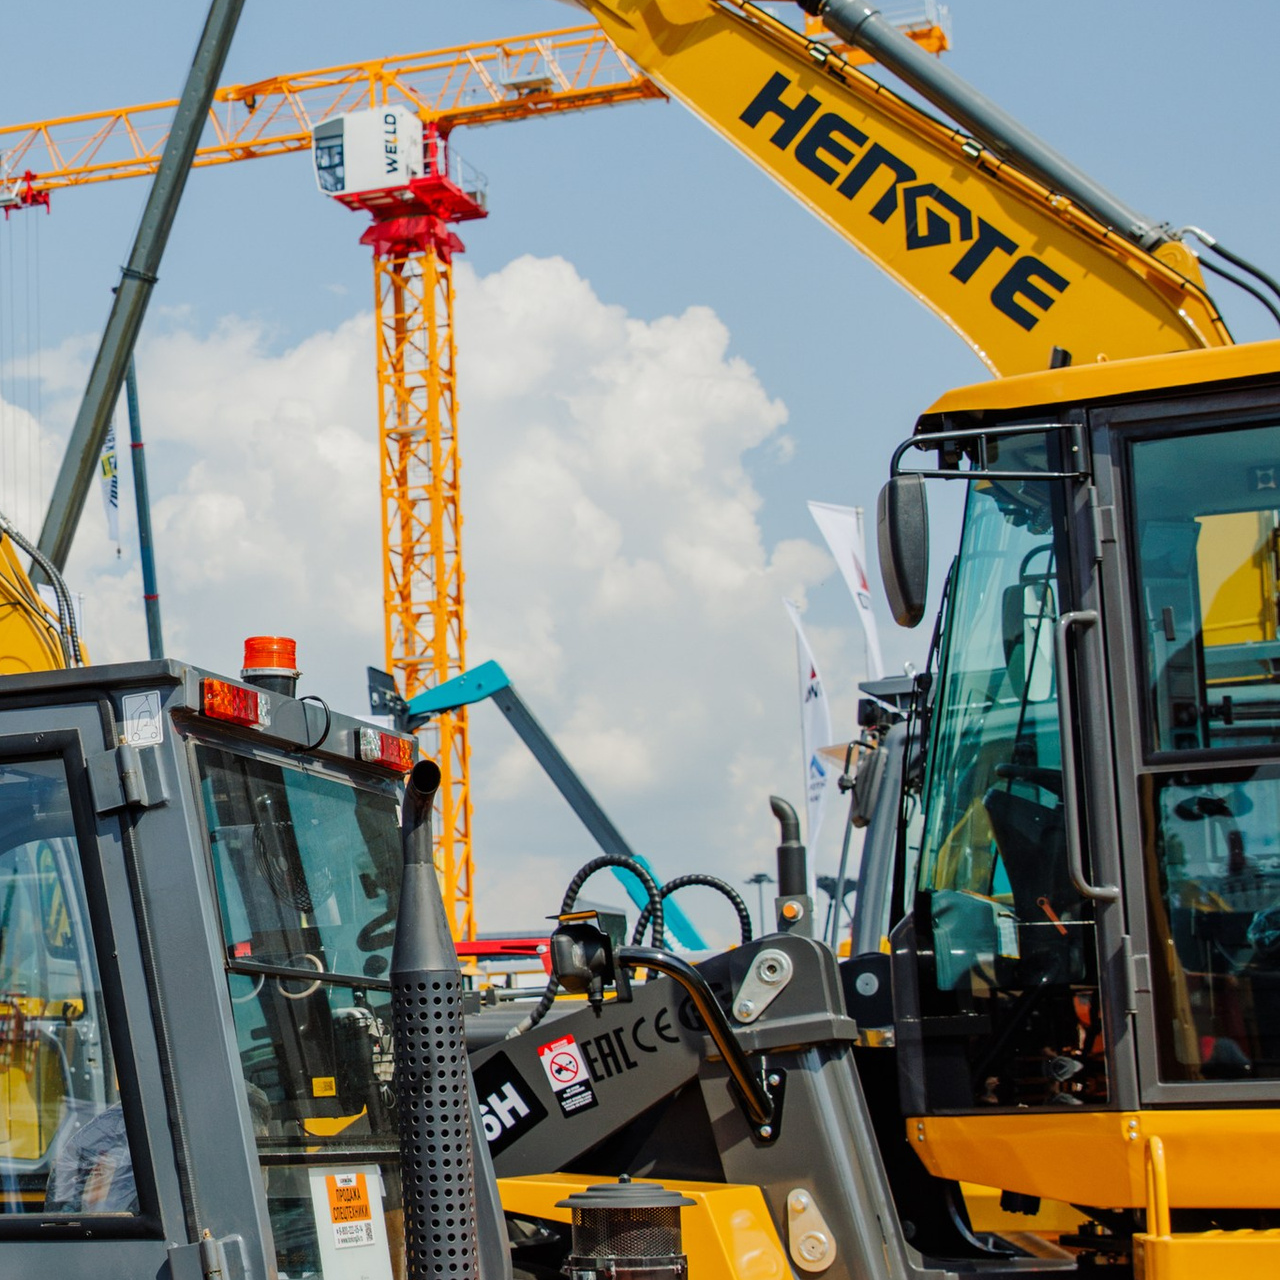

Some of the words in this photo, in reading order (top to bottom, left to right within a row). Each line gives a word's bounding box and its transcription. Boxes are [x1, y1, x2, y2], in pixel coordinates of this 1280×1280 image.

[739, 71, 1070, 332] HENGTE
[336, 1188, 361, 1202] ПРОДАЖА
[333, 1204, 369, 1221] СПЕЦТЕХНИКИ
